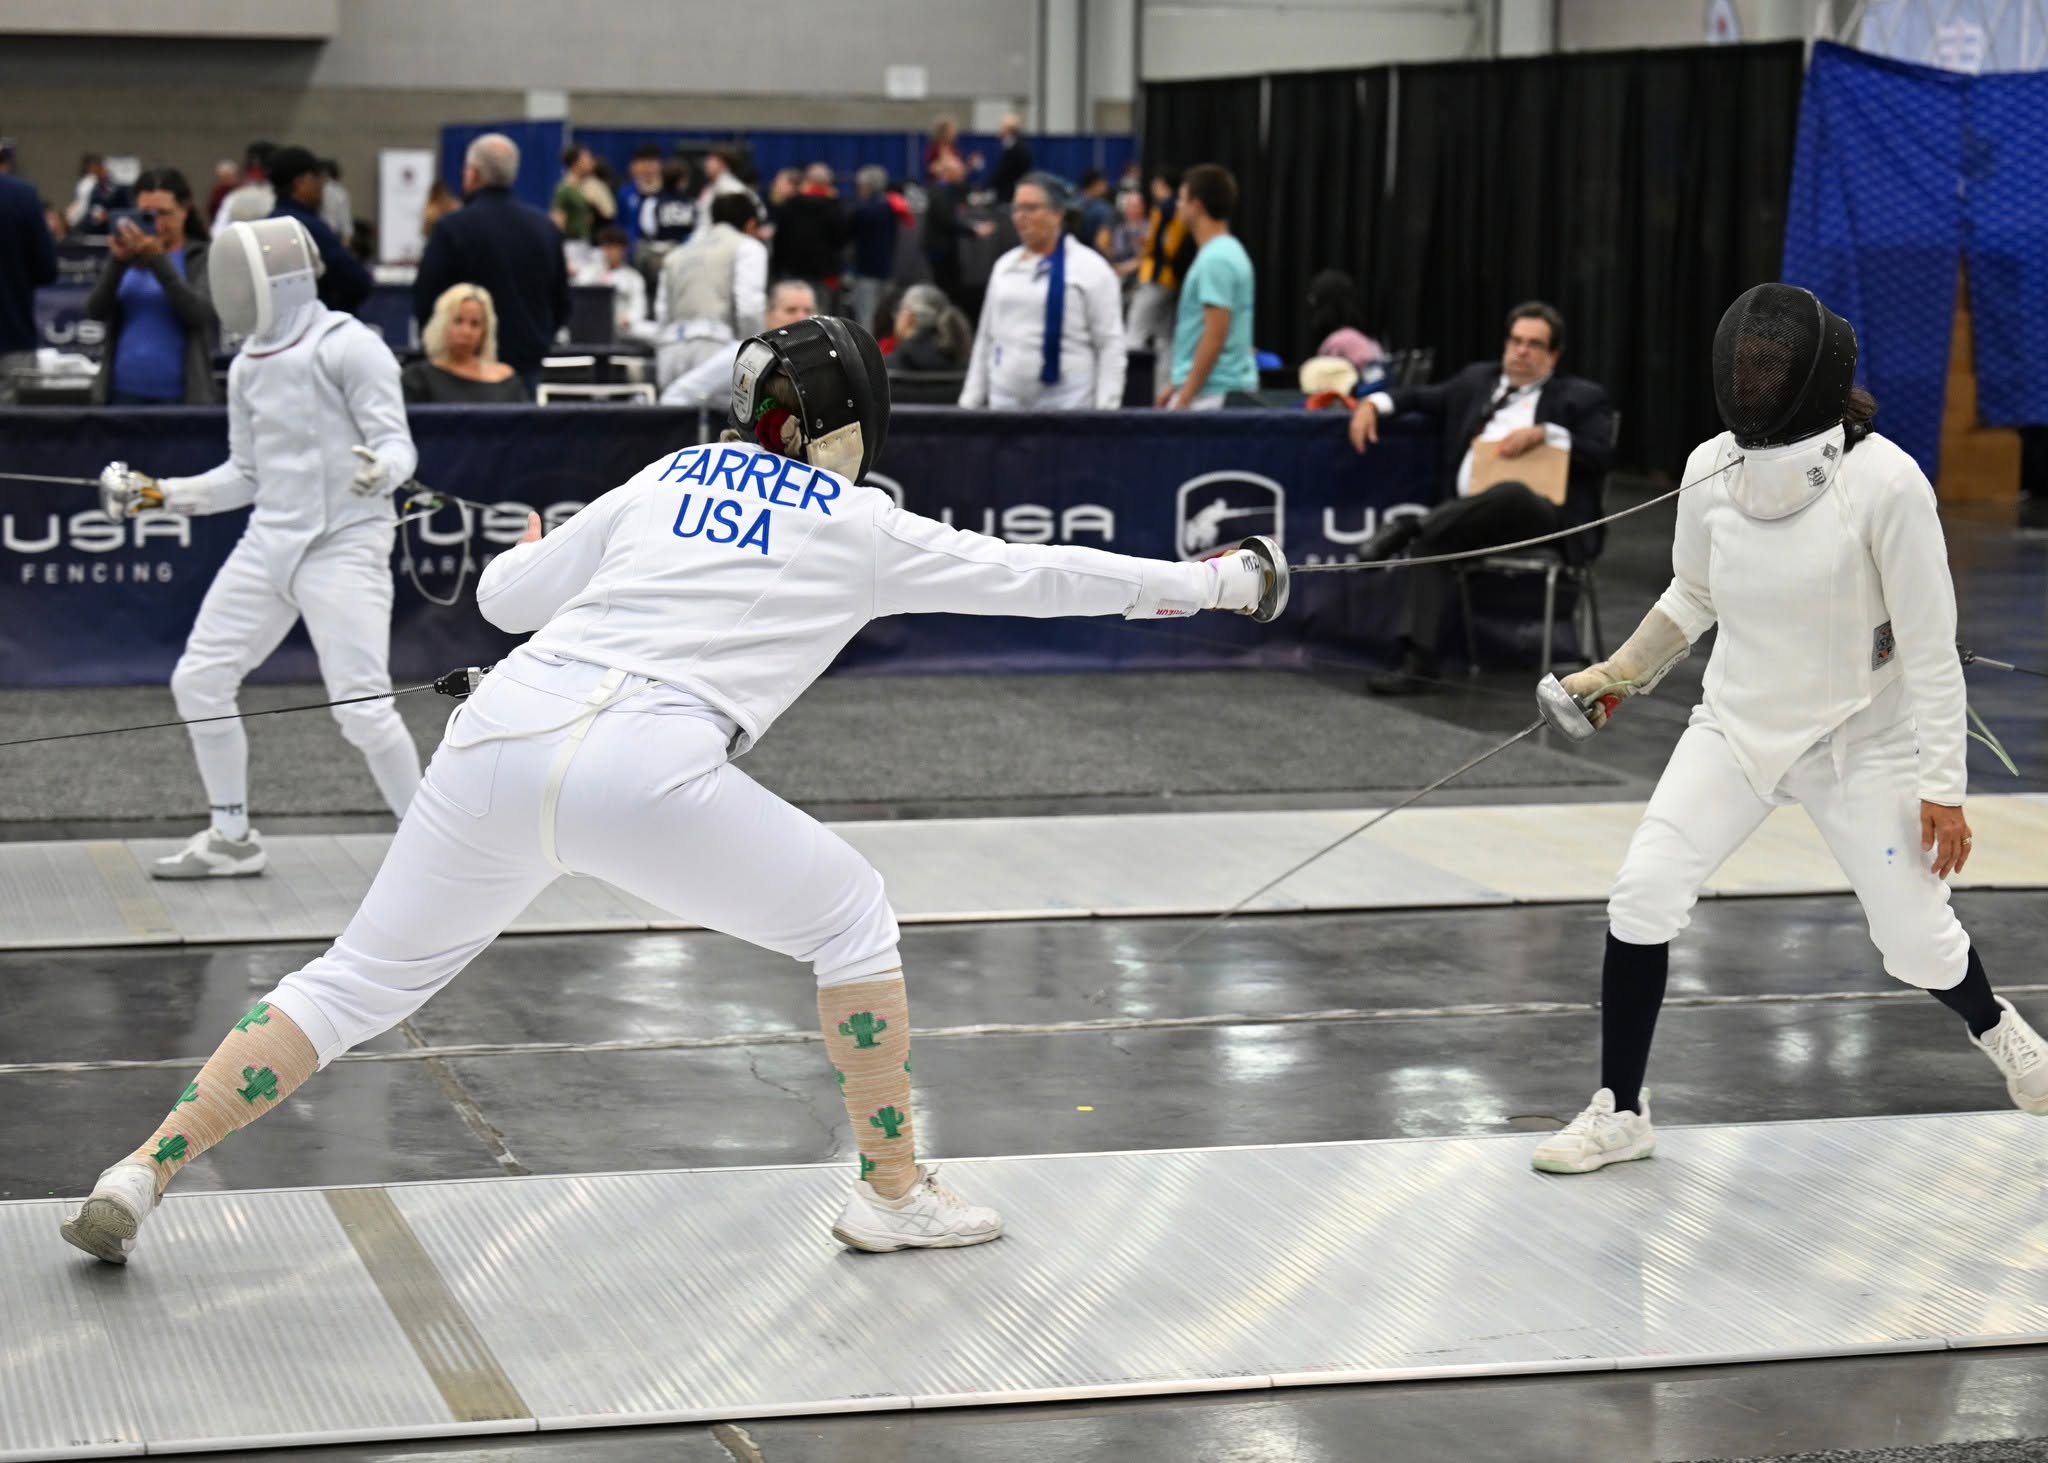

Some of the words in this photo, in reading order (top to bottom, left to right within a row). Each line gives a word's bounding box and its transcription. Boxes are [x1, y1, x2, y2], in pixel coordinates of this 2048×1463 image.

[658, 449, 841, 516] FARRER
[3, 510, 191, 552] USA
[672, 494, 771, 555] USA
[22, 562, 173, 584] FENCING
